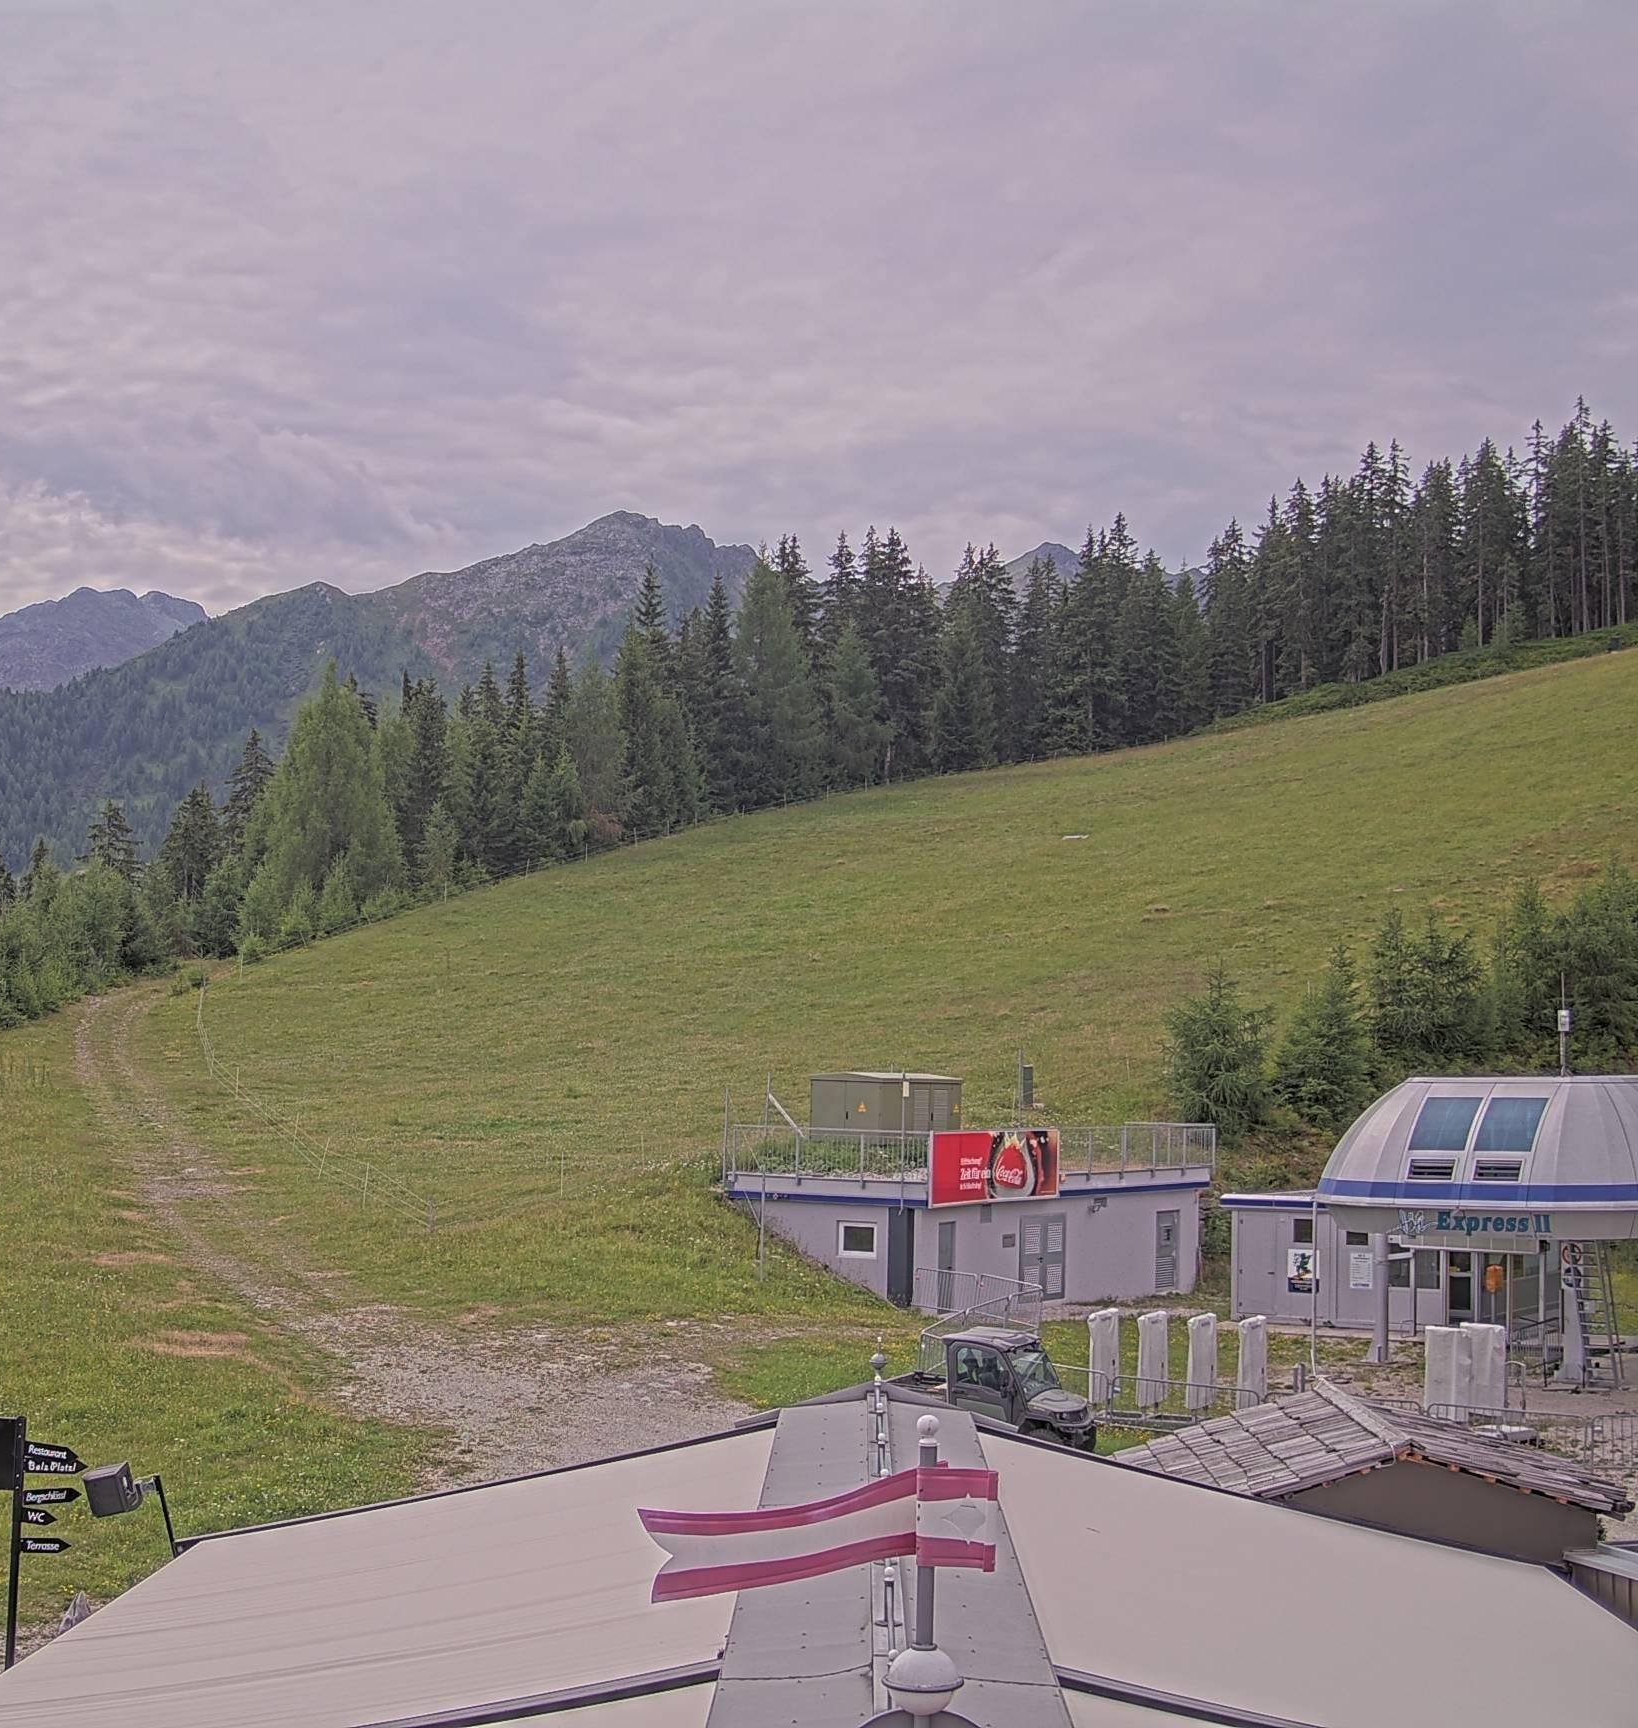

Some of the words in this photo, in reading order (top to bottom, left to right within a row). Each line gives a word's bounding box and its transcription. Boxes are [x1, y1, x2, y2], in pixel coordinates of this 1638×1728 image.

[1436, 1211, 1529, 1236] Express
[1534, 1214, 1551, 1233] II
[28, 1444, 67, 1459] Restaurant
[27, 1511, 45, 1522] WC
[26, 1540, 60, 1551] Terrasse
